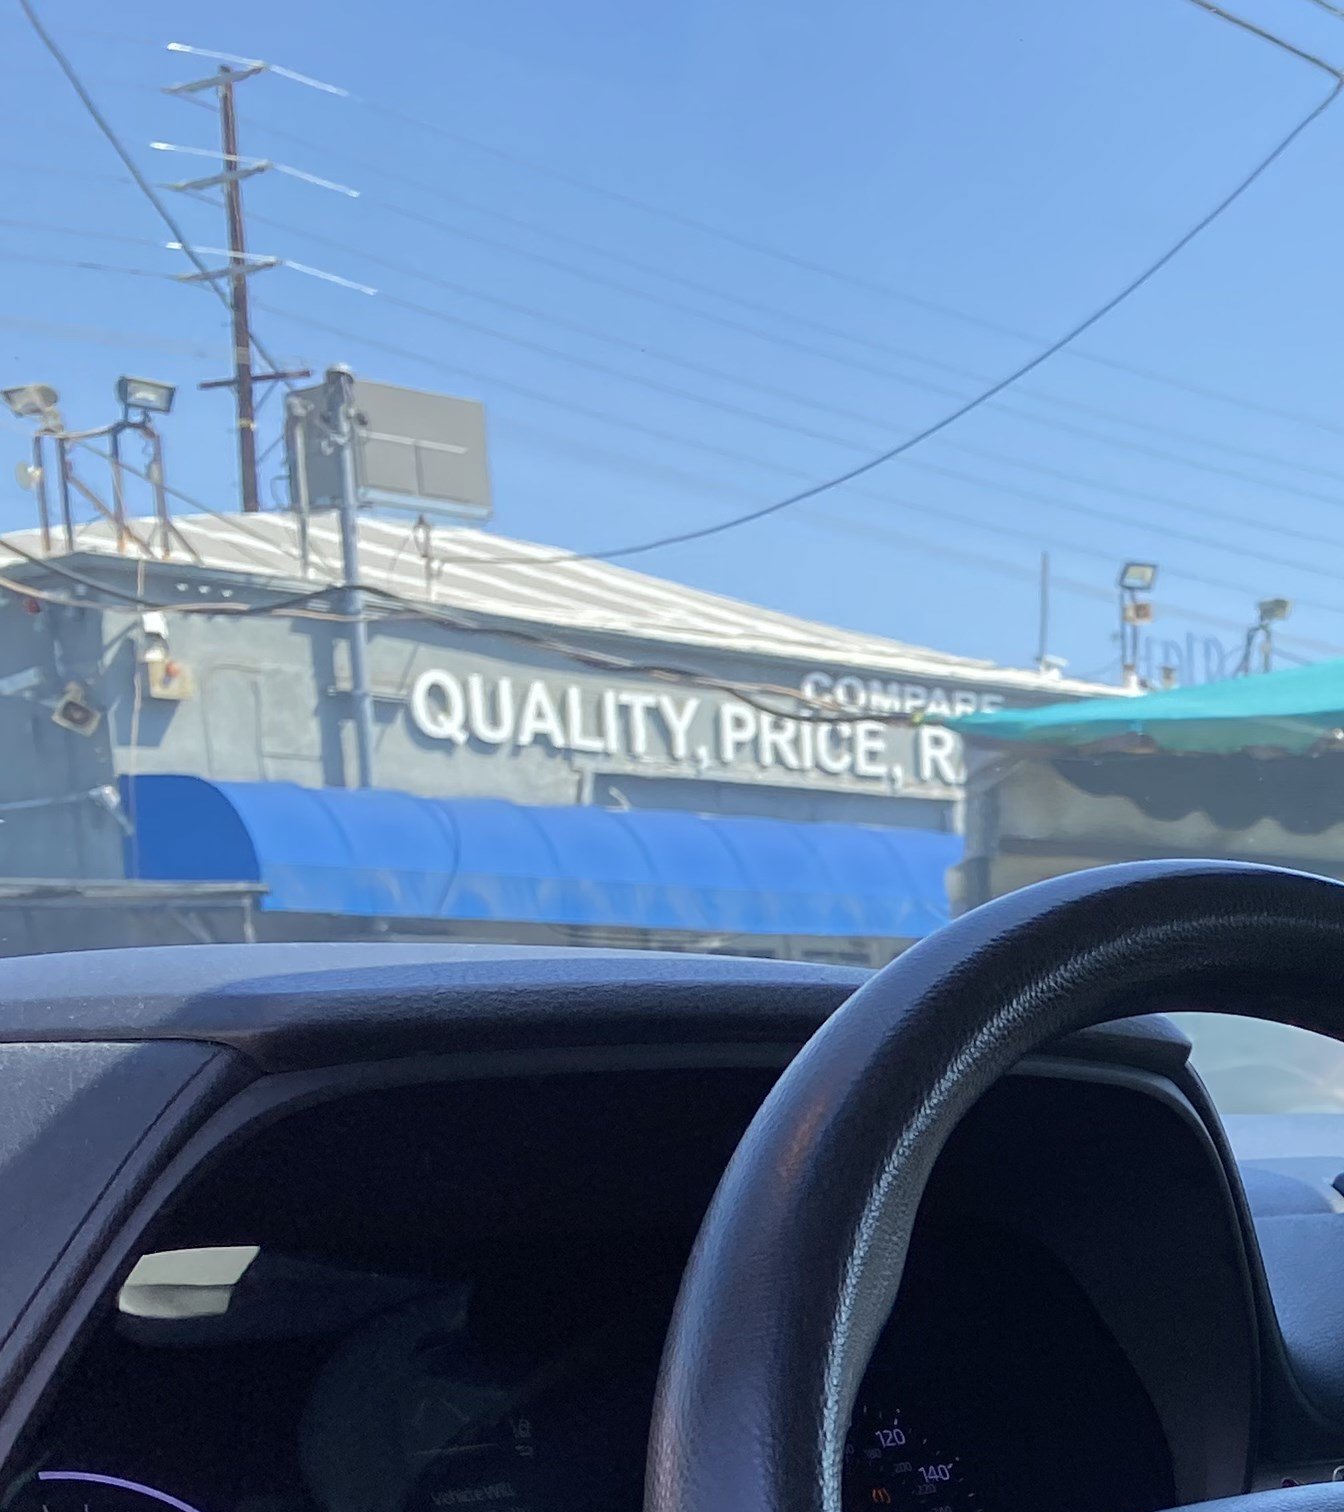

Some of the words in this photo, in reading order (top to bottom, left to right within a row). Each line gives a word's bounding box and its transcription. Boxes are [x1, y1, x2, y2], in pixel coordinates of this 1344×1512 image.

[411, 669, 711, 768] QUALITY,
[719, 703, 903, 789] PRICE,
[875, 1428, 906, 1449] 120
[917, 1463, 951, 1483] 140
